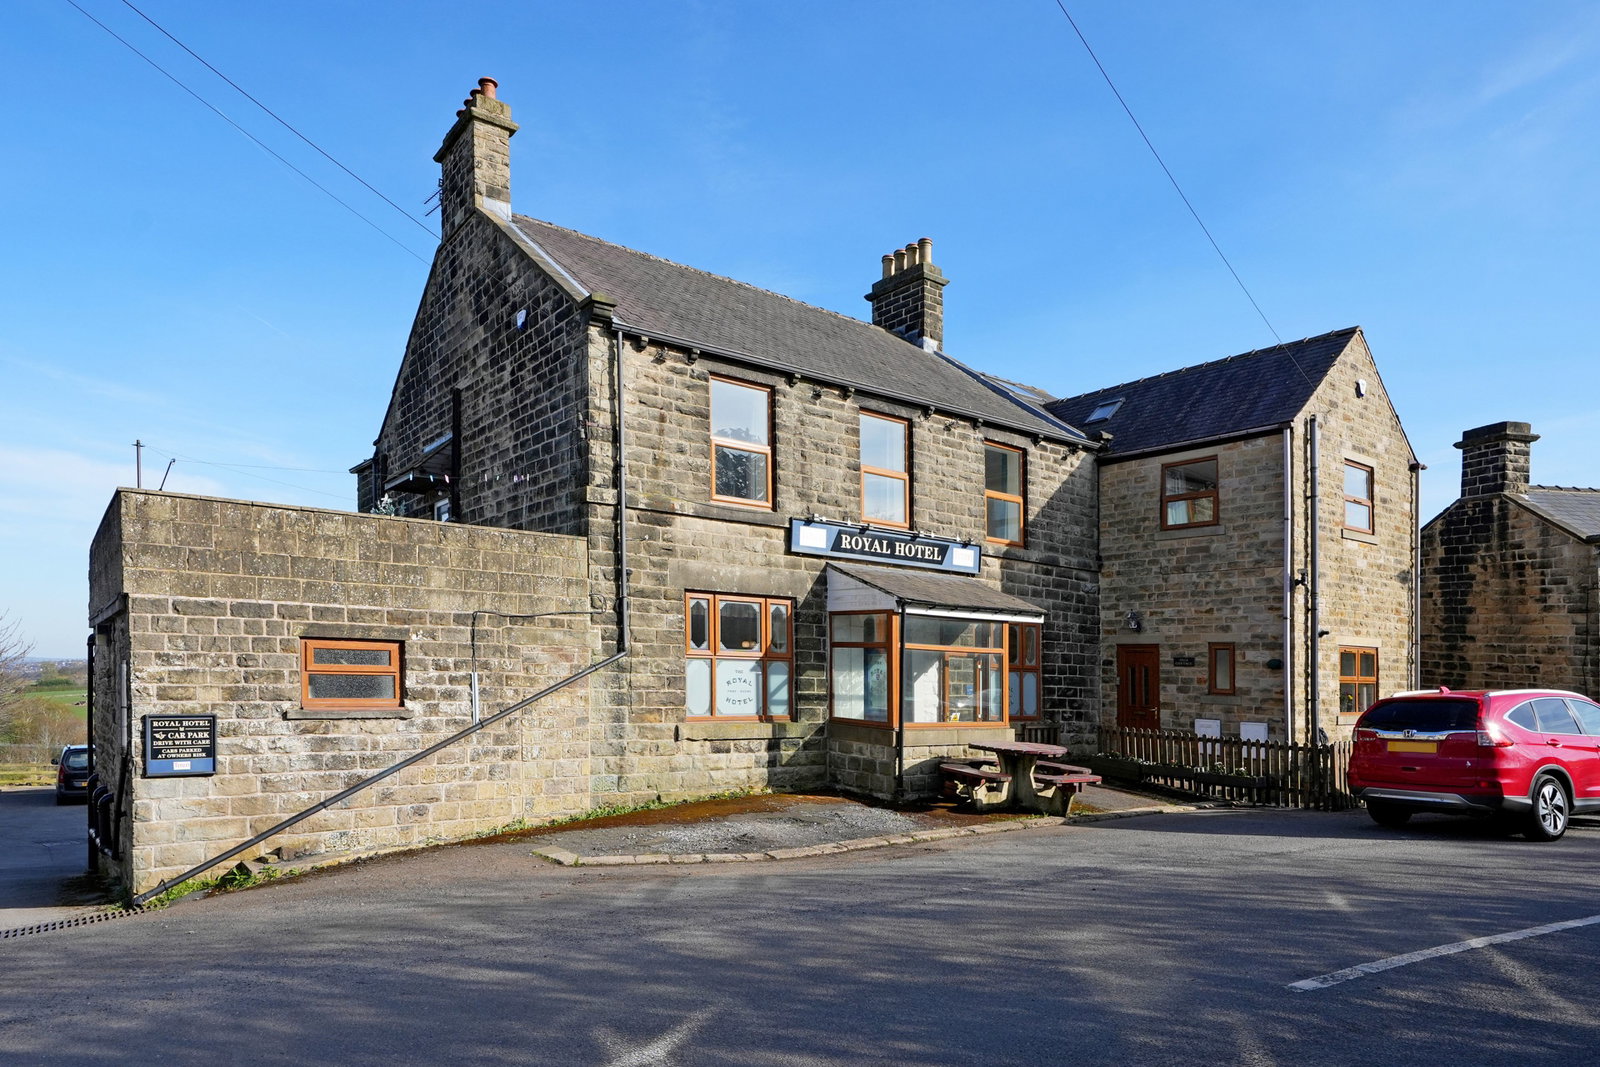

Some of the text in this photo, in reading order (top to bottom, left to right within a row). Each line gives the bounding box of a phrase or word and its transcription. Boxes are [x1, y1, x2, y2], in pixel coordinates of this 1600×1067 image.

[840, 534, 891, 555] ROYAL
[894, 542, 942, 560] HOTEL
[726, 678, 752, 686] ROYAL
[726, 697, 753, 706] HOTEL
